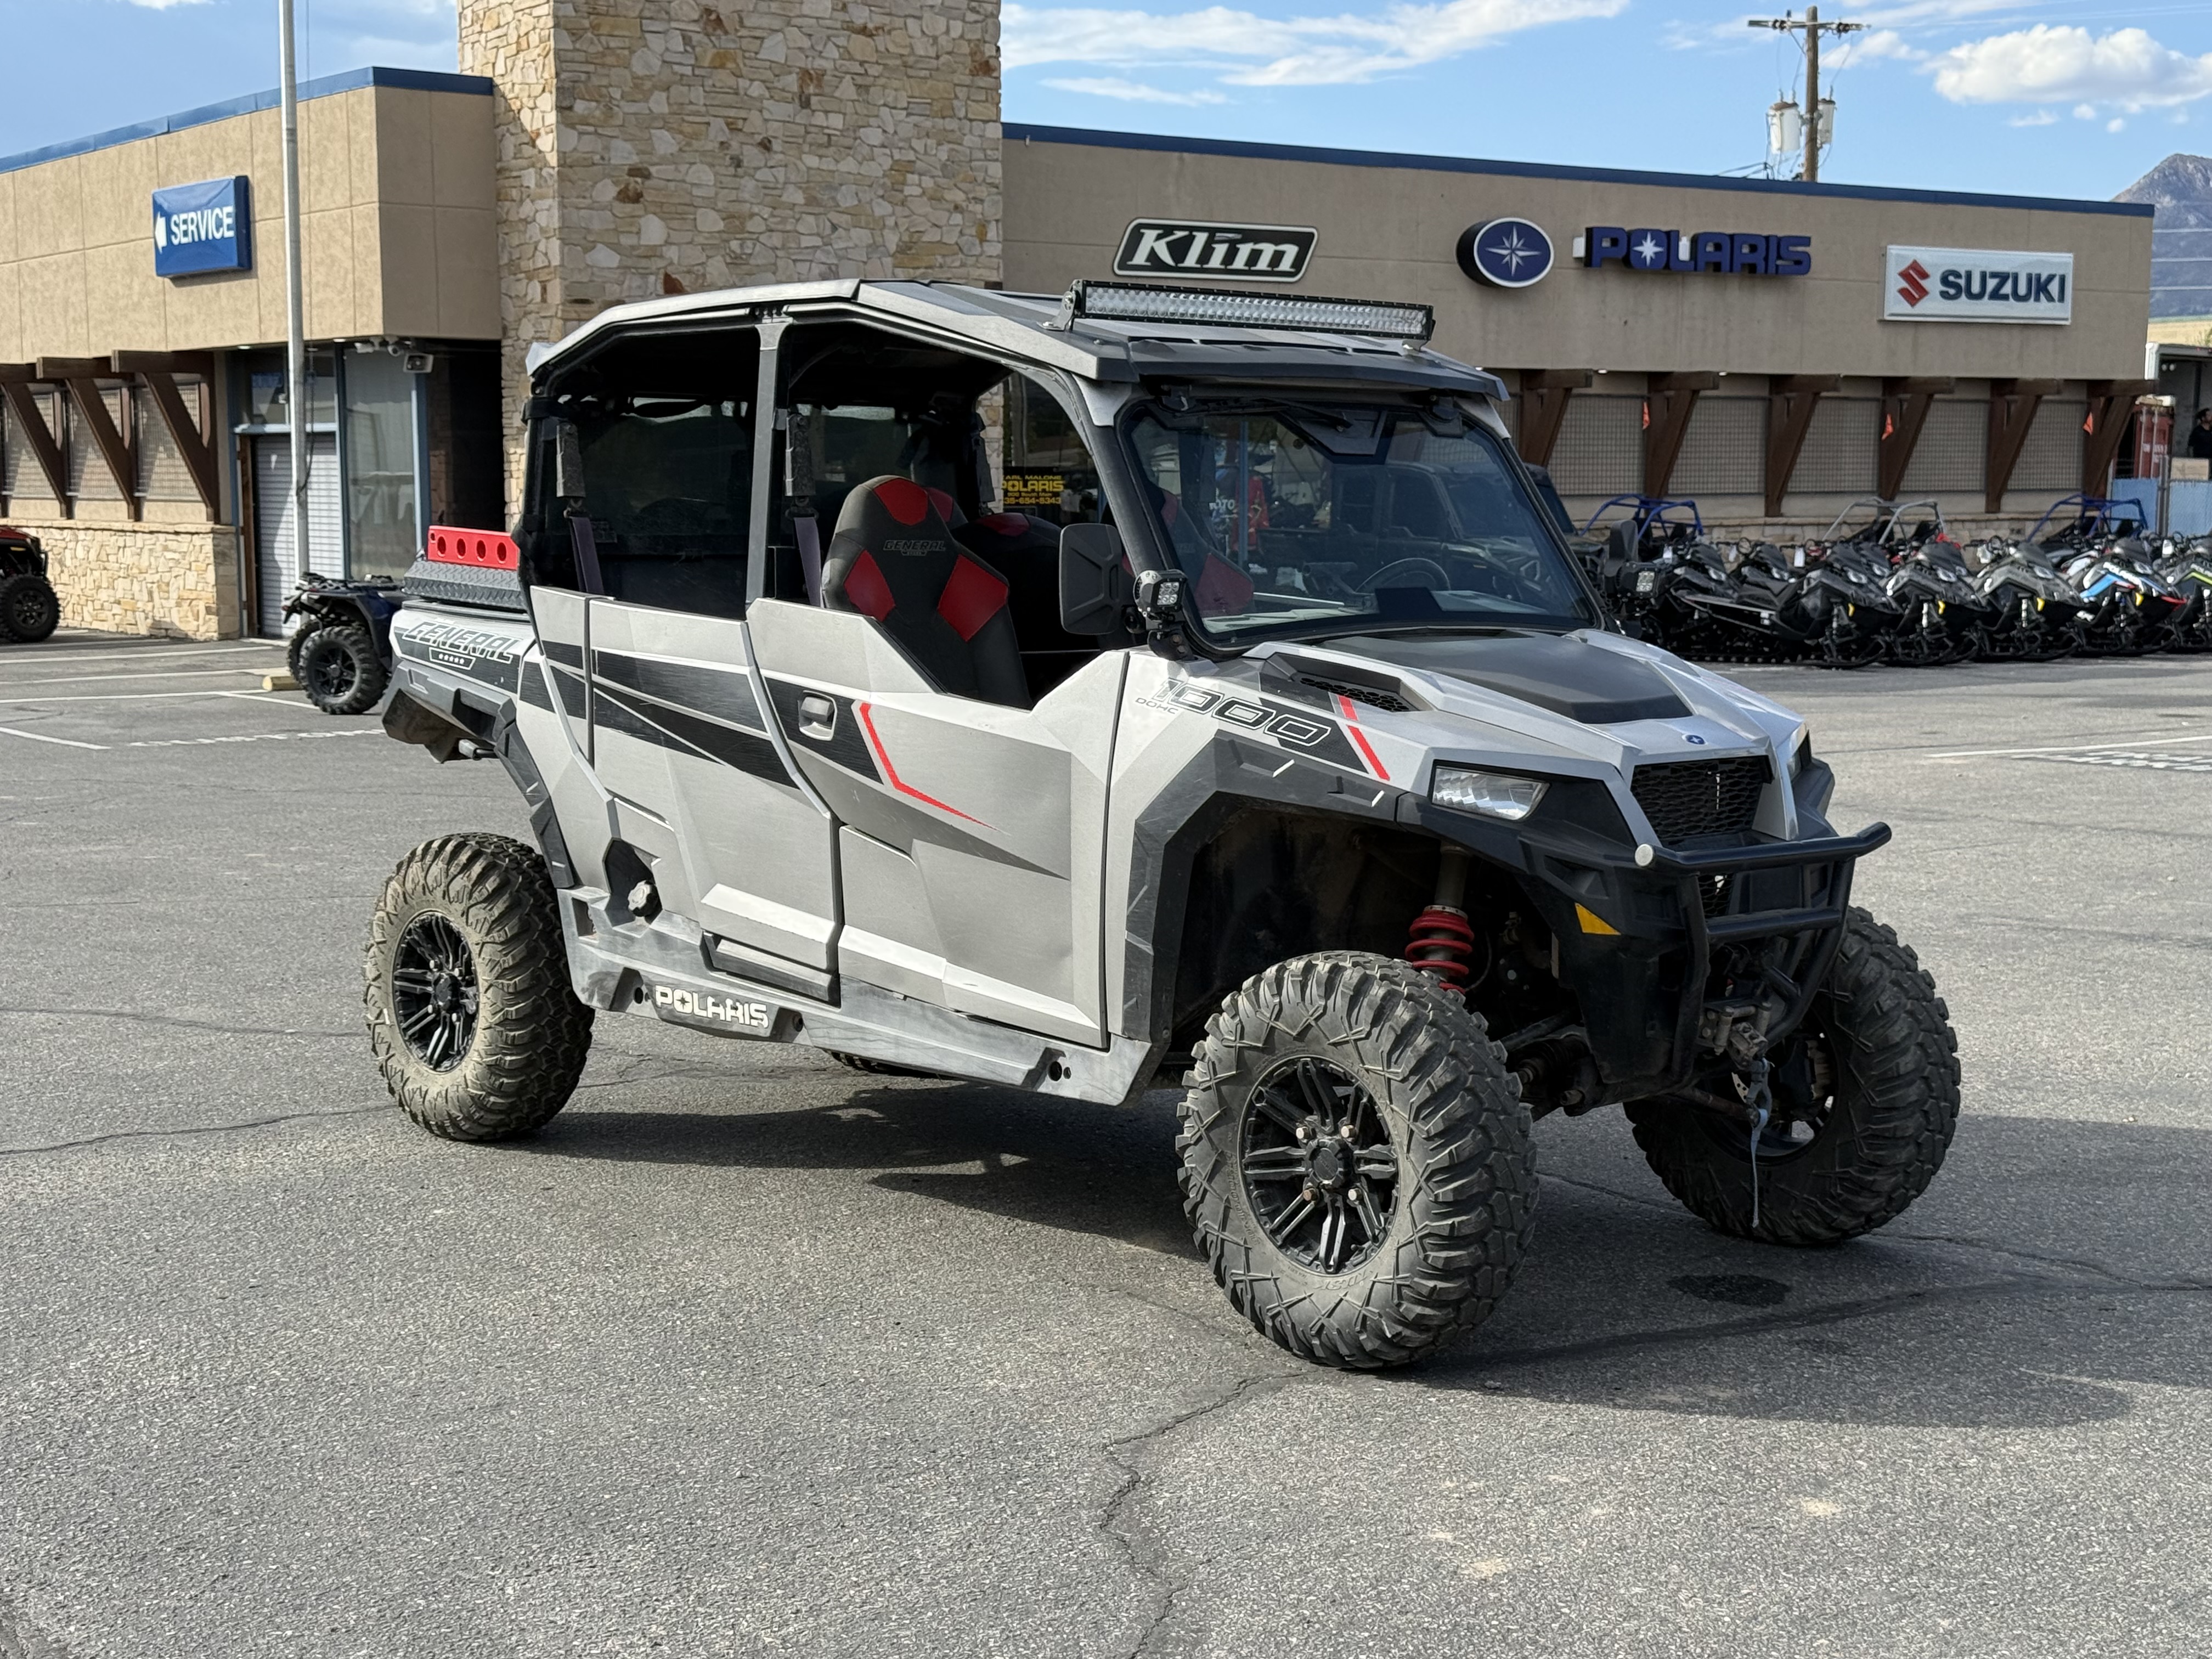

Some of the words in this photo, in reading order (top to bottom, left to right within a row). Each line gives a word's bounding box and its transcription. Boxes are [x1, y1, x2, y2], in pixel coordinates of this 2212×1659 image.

[171, 206, 235, 246] SERVICE
[1126, 228, 1300, 272] Klim
[1585, 227, 1811, 275] POLARIS
[1939, 269, 2066, 303] SUZUKI
[883, 540, 946, 551] GENERAL
[402, 620, 523, 664] GENERAL
[1135, 697, 1179, 715] DOHC
[1152, 676, 1331, 746] 1000
[654, 985, 769, 1029] POLARIS
